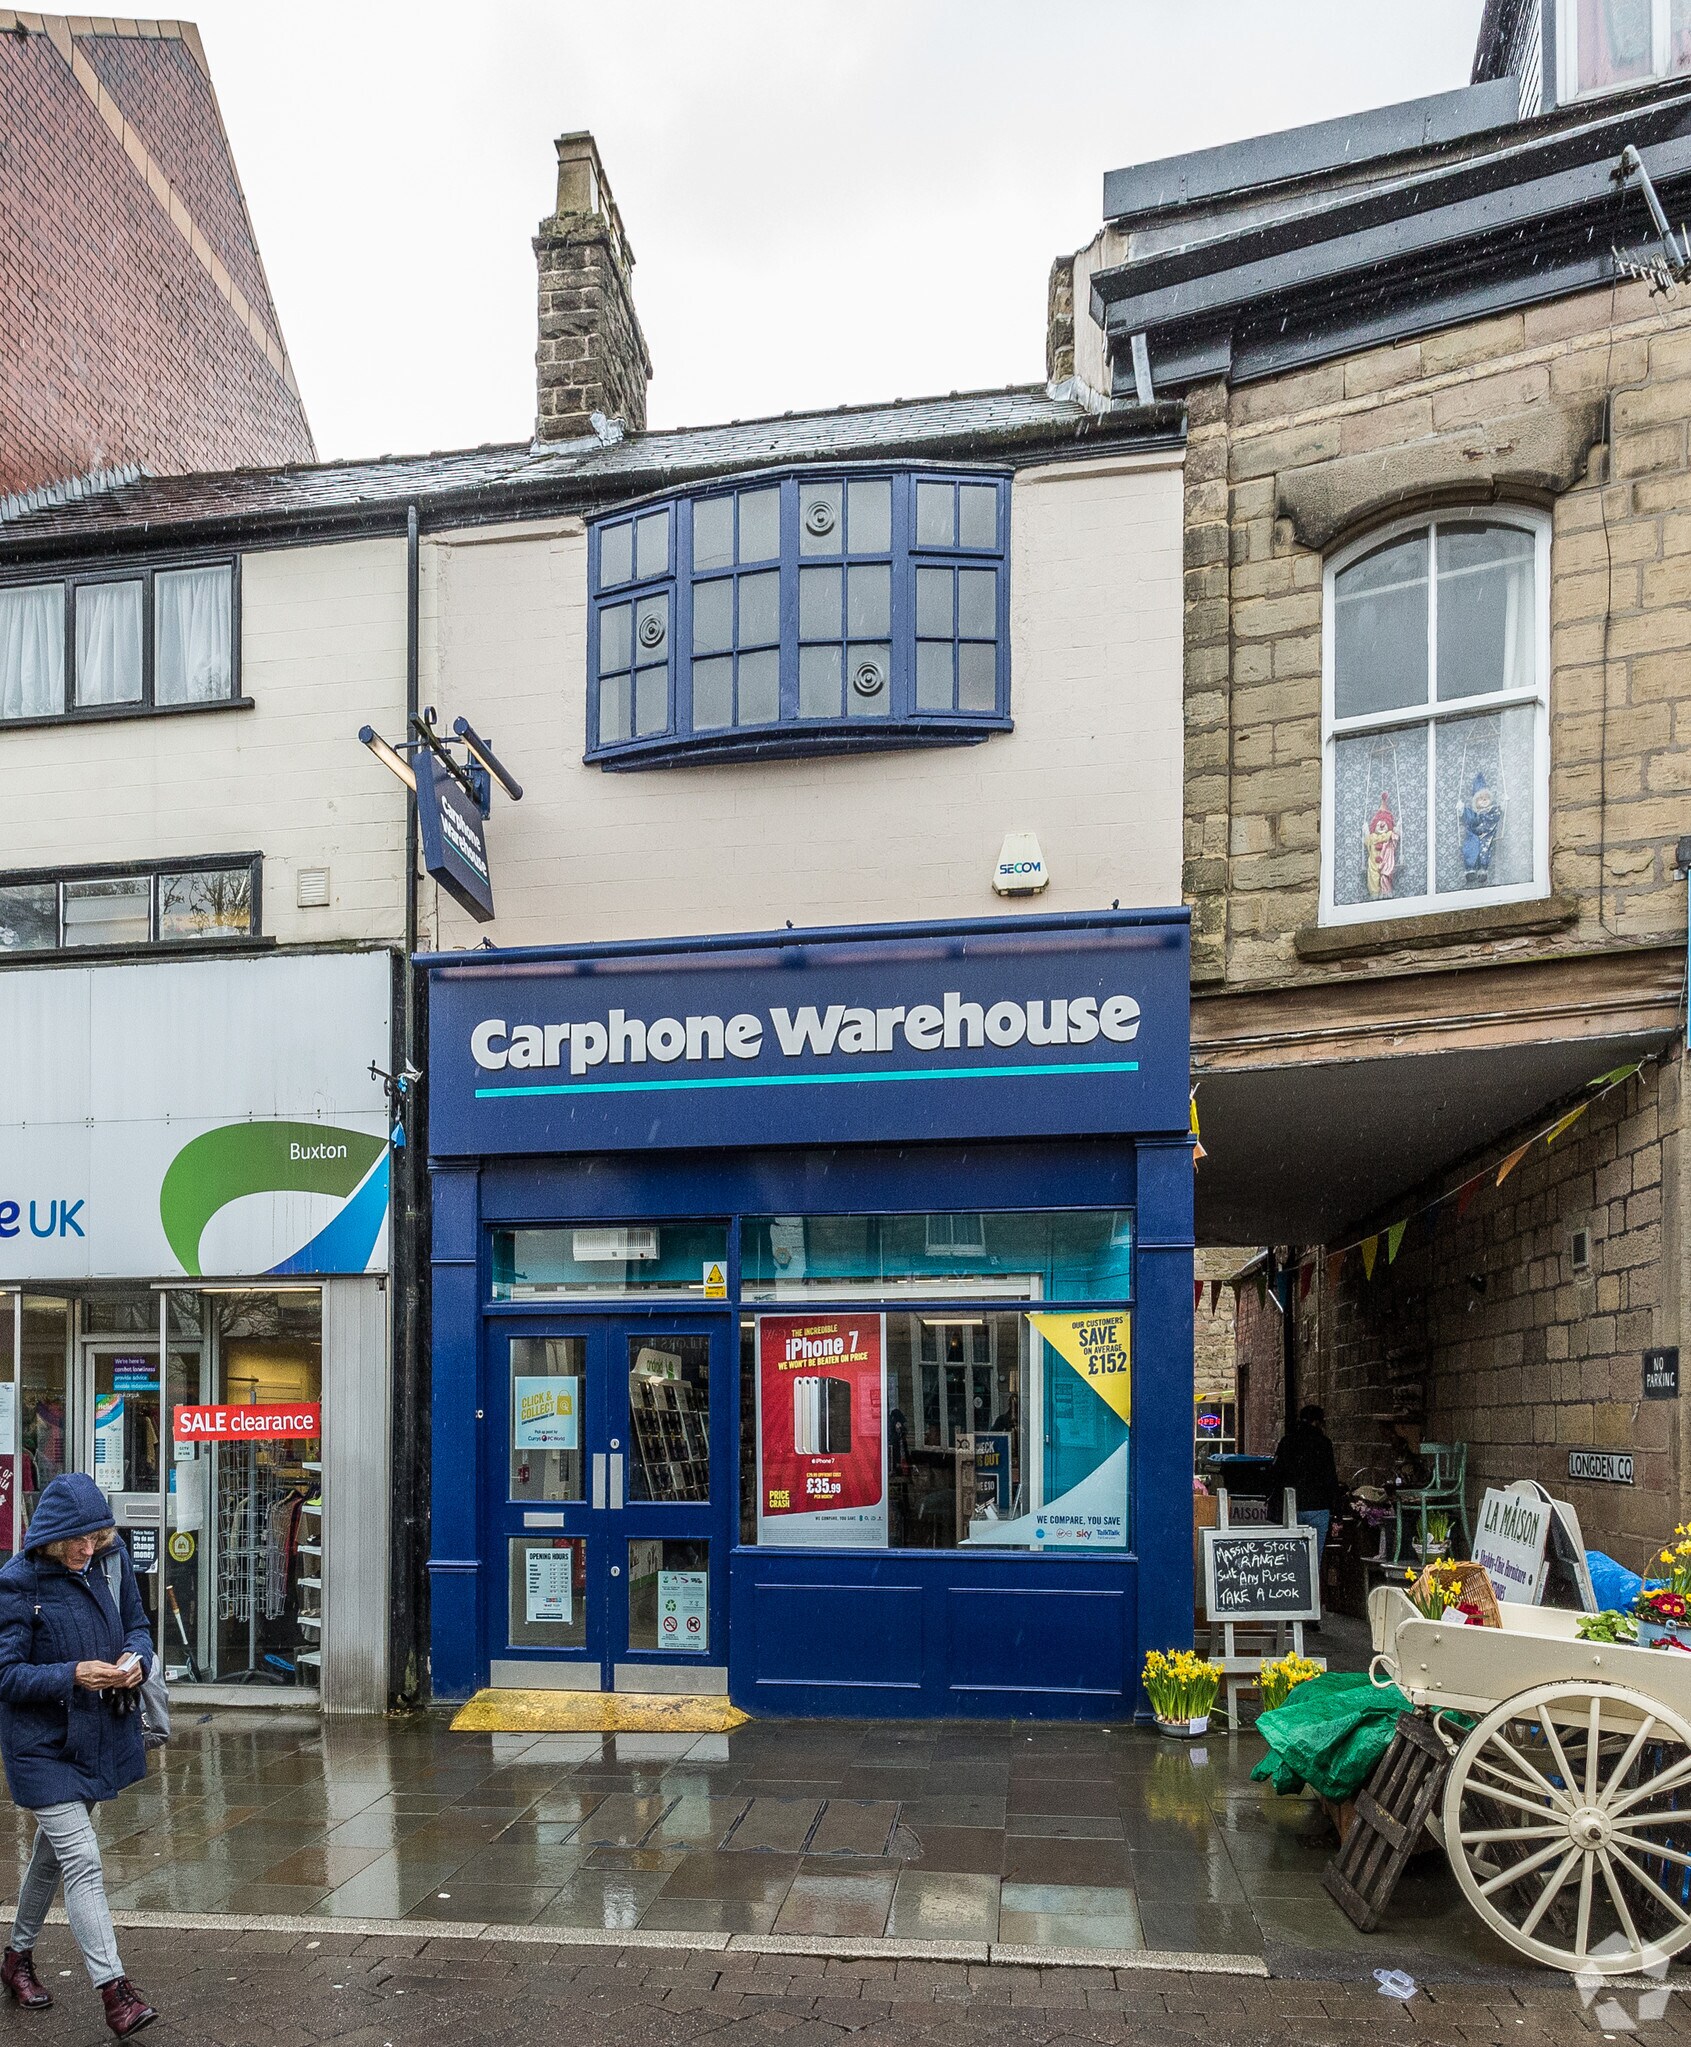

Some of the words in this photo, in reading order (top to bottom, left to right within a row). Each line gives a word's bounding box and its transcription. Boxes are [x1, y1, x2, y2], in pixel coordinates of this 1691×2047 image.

[442, 795, 482, 852] Carphone
[440, 813, 488, 878] Warehouse
[1000, 862, 1041, 875] SECOM
[471, 1009, 763, 1076] Carphone
[772, 992, 1141, 1058] Warehouse
[290, 1143, 348, 1161] Buxton
[29, 1200, 86, 1237] UK
[791, 1329, 803, 1337] THE
[804, 1324, 838, 1336] INCREDIBLE
[1072, 1321, 1084, 1329] OUR
[1086, 1317, 1123, 1328] CUSTOMERS
[1079, 1325, 1117, 1347] SAVE
[785, 1337, 844, 1360] iPhone
[848, 1331, 859, 1353] 7
[1094, 1344, 1122, 1354] AVERAGE
[778, 1362, 788, 1371] WE
[789, 1360, 807, 1369] WON'T
[808, 1358, 816, 1367] BE
[817, 1355, 839, 1365] BEATEN
[840, 1354, 849, 1363] ON
[850, 1352, 868, 1362] PRICE
[1088, 1352, 1127, 1375] £152
[1653, 1357, 1664, 1371] NO
[1646, 1372, 1675, 1387] PARKING
[522, 1393, 544, 1408] CLICK
[546, 1391, 553, 1401] &
[521, 1401, 554, 1420] COLLECT
[180, 1412, 227, 1433] SALE
[231, 1410, 313, 1431] clearance
[984, 1453, 1000, 1466] OUT
[1570, 1454, 1614, 1478] LONGDEN
[1618, 1458, 1633, 1480] CO
[806, 1478, 841, 1494] £35.99
[769, 1491, 790, 1500] PRICE
[769, 1500, 790, 1508] CRASH
[1037, 1515, 1047, 1524] WE
[1049, 1515, 1086, 1525] COMPARE,
[1087, 1516, 1102, 1525] YOU
[1103, 1517, 1121, 1525] SAVE
[1230, 1508, 1267, 1520] AISON
[1484, 1500, 1499, 1534] LA
[1500, 1504, 1540, 1548] MAISON
[1076, 1529, 1092, 1540] sky
[133, 1542, 154, 1550] change
[133, 1551, 154, 1559] money
[1262, 1569, 1297, 1583] Purse
[1504, 1560, 1527, 1584] Furniture
[1220, 1588, 1251, 1605] TAKE
[1256, 1588, 1265, 1601] A
